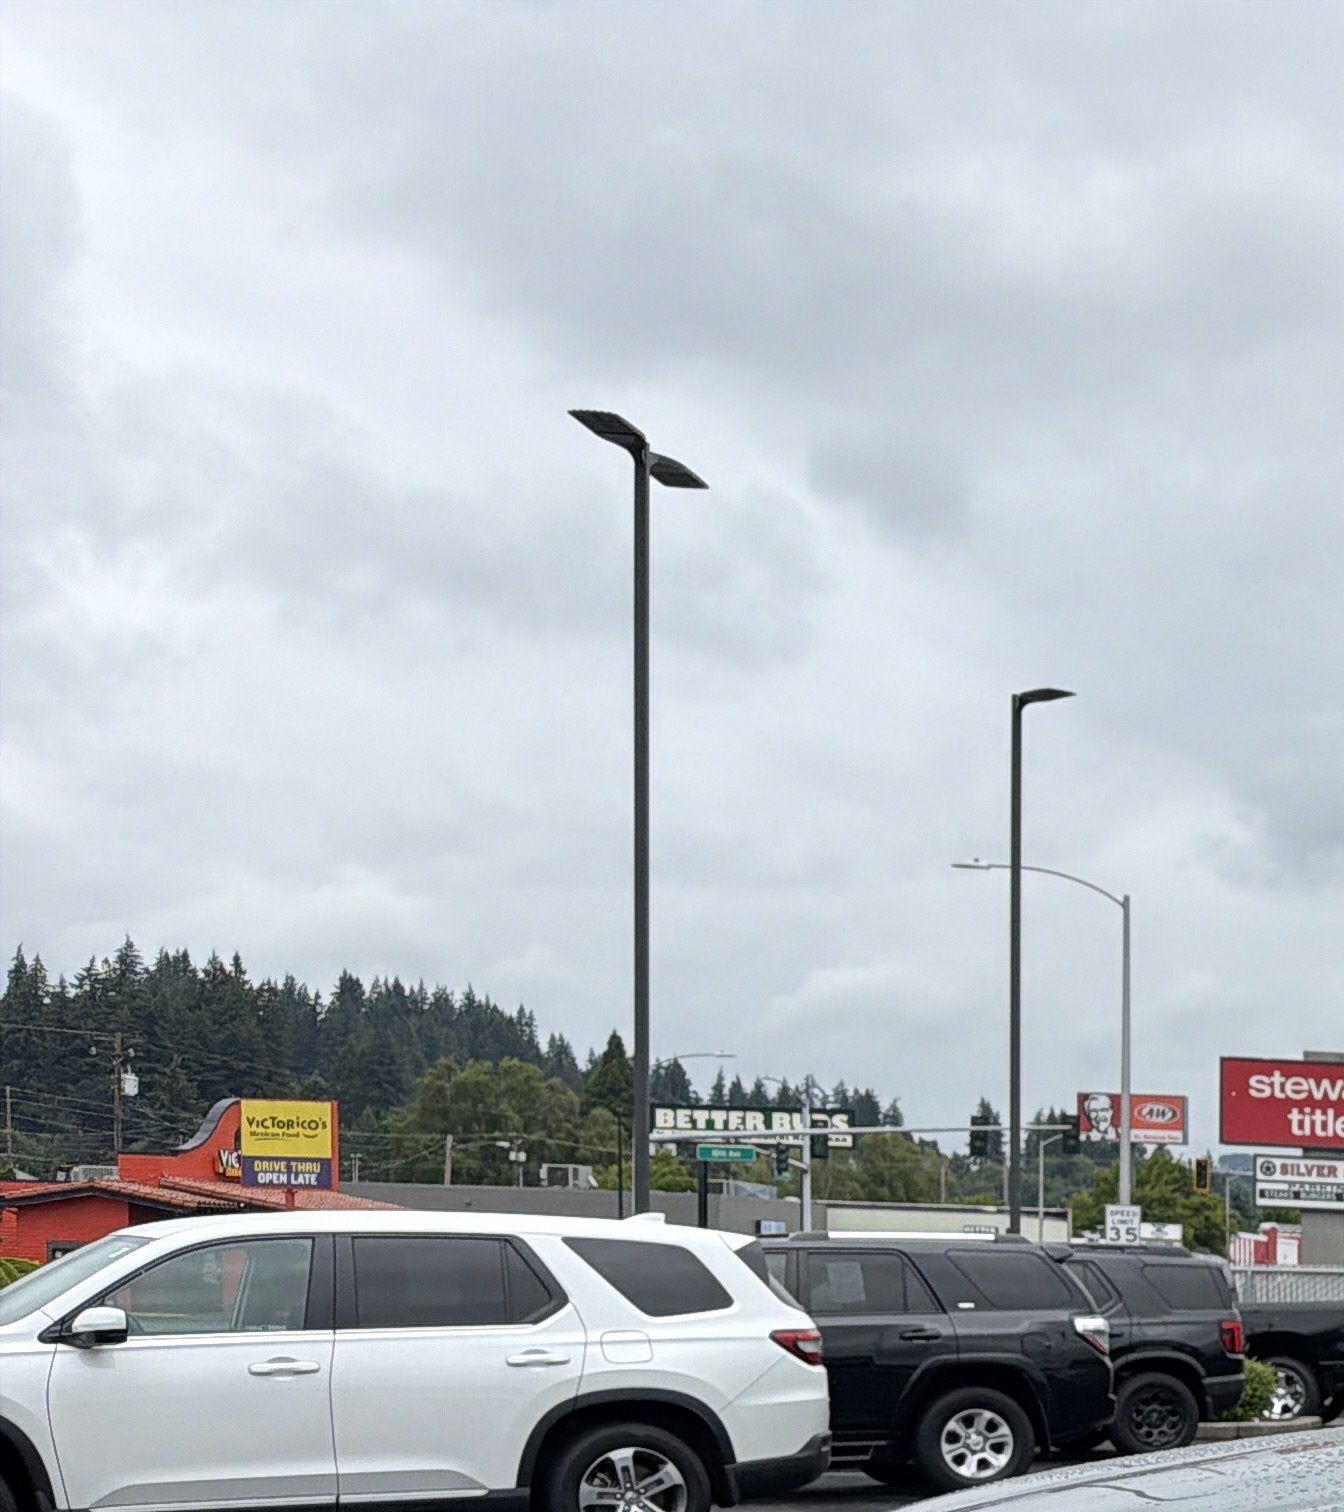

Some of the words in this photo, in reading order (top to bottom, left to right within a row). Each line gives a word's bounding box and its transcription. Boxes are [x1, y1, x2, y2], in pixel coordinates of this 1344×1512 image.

[655, 1108, 766, 1131] BETTER
[254, 1160, 287, 1173] DRIVE
[289, 1161, 321, 1174] THRU
[1280, 1162, 1338, 1178] SILVER
[257, 1172, 287, 1184] OPEN
[290, 1173, 318, 1186] LATE
[1109, 1209, 1137, 1217] SPEED
[1109, 1226, 1138, 1243] 35
